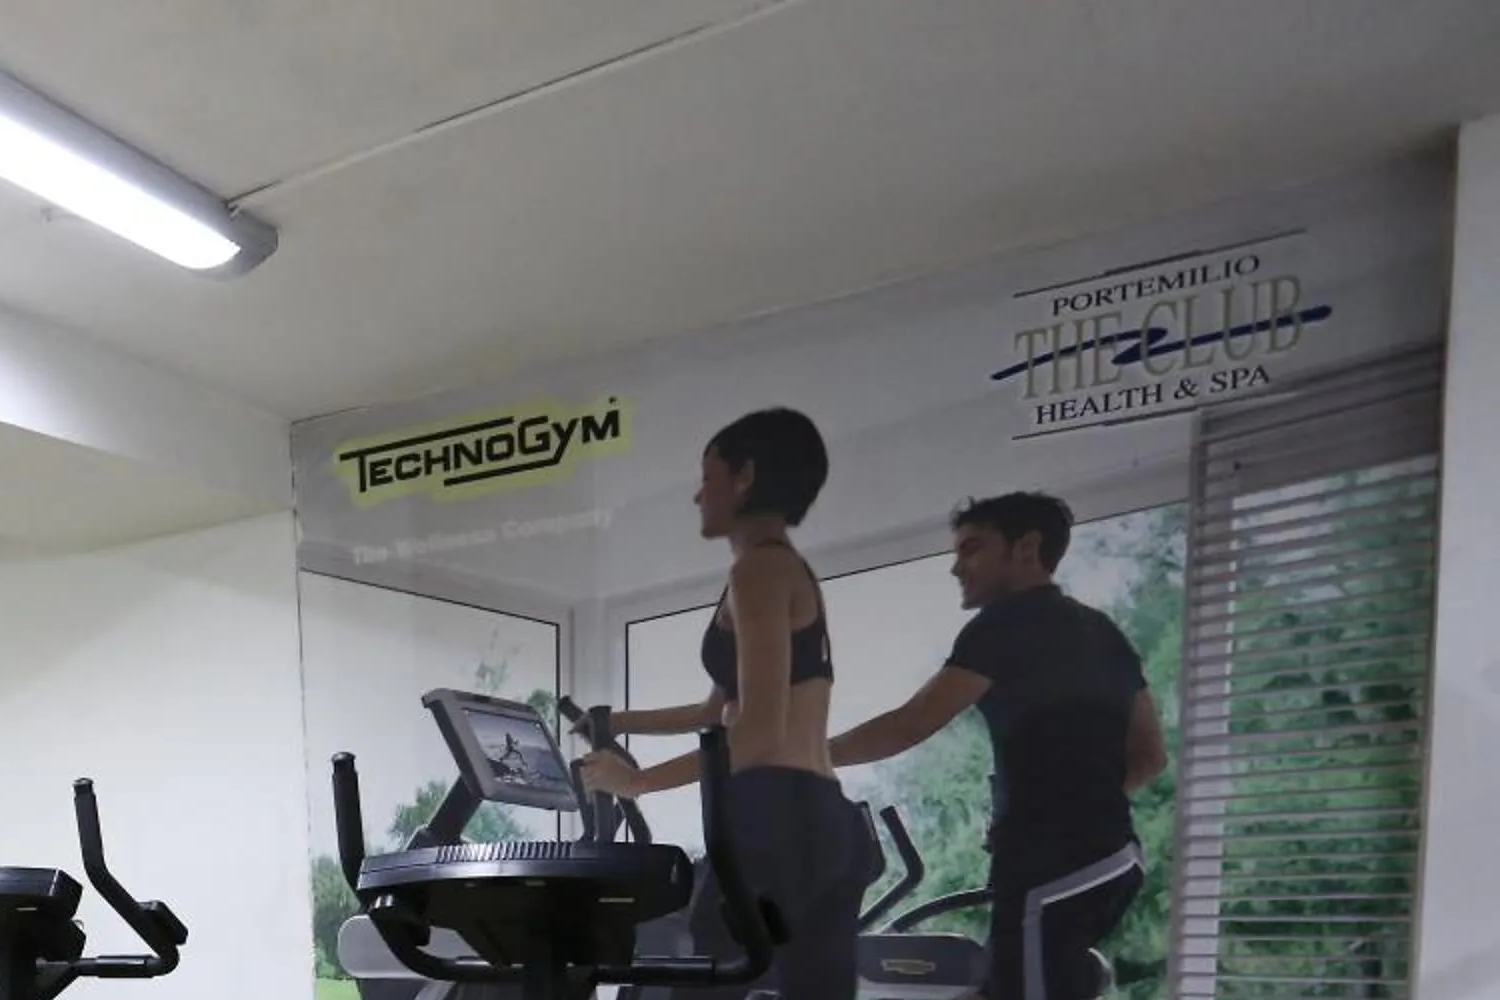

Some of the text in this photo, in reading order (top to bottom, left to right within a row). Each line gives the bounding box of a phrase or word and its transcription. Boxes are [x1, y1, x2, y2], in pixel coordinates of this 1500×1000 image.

[1052, 254, 1261, 316] PORTEMILIO
[1013, 273, 1305, 400] THE CLUB
[1035, 364, 1271, 425] HEALTH & SPA
